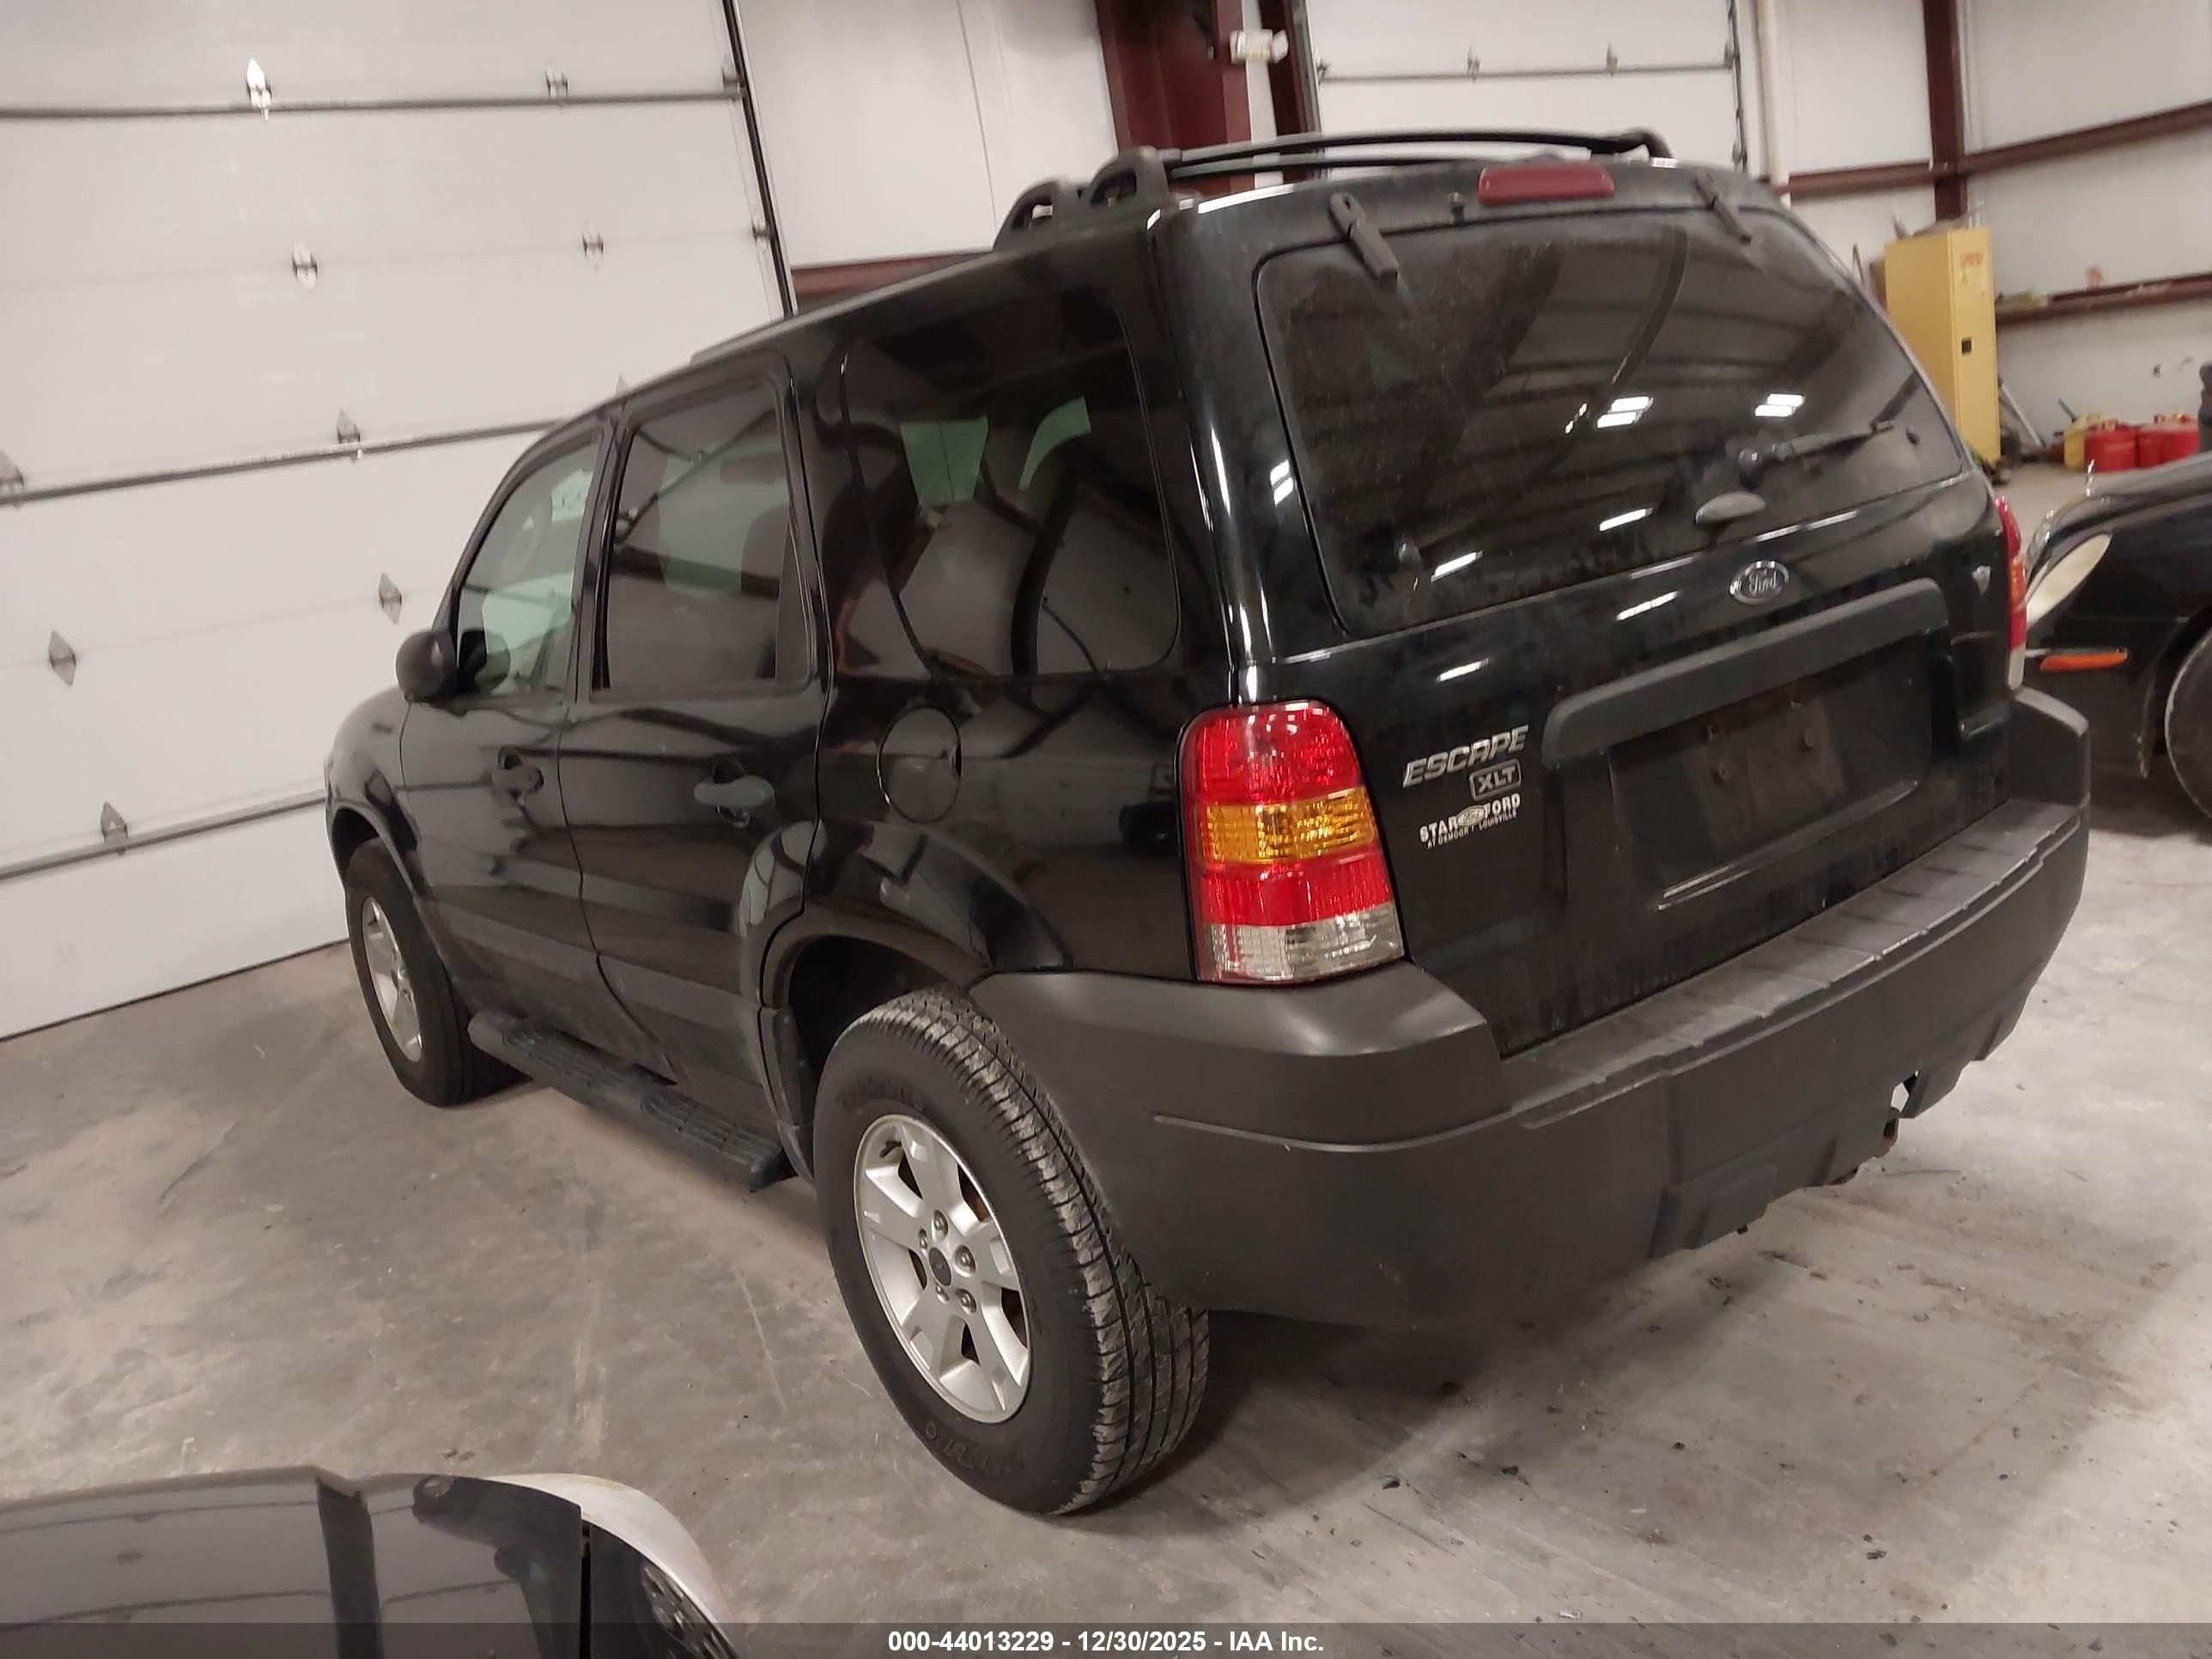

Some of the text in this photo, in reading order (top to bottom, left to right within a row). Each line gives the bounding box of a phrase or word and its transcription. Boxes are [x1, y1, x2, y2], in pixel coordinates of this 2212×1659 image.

[1738, 567, 1784, 599] Ford
[1402, 724, 1528, 788] ESCAPE
[1477, 766, 1516, 794] XLT
[1419, 815, 1459, 842] STAR
[1483, 793, 1521, 819] FORD
